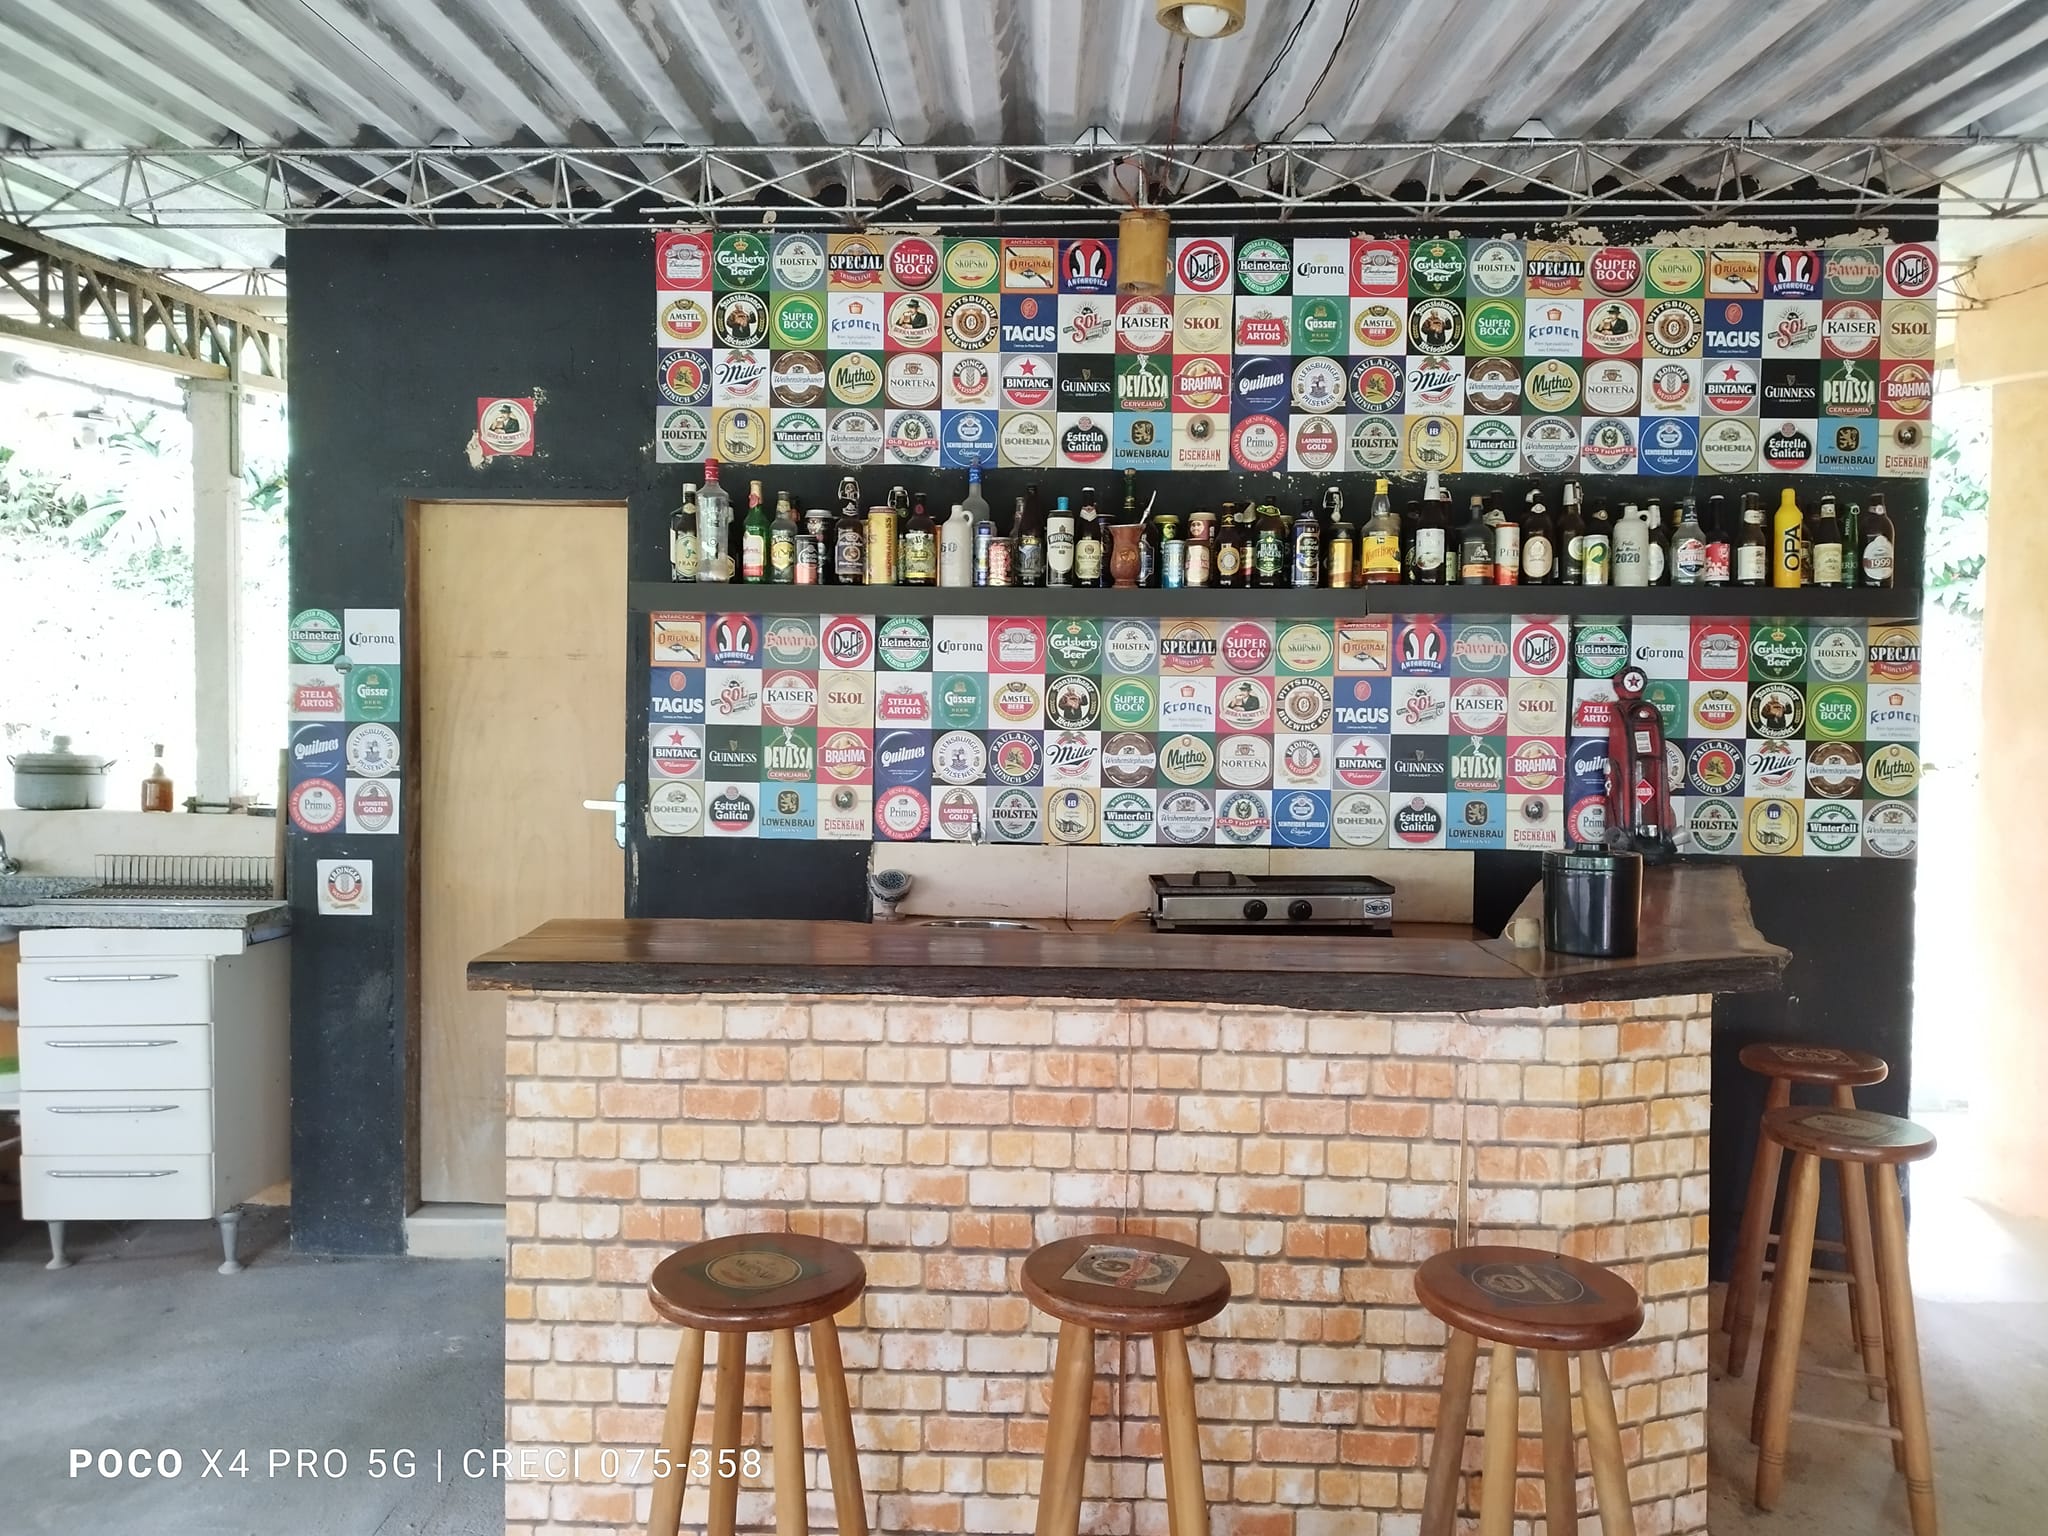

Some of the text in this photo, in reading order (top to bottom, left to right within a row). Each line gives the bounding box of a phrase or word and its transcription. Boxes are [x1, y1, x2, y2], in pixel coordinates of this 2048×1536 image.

[718, 251, 765, 265] Carlsberg
[780, 258, 817, 266] HOLSTEN
[830, 256, 883, 269] SPECJAL
[894, 252, 934, 263] SUPER
[896, 263, 932, 274] BOCK
[955, 260, 988, 268] SKOPSKO
[1009, 260, 1052, 269] ORIGINAL
[1189, 254, 1220, 282] Duff
[1239, 261, 1288, 271] Heineken
[1297, 262, 1344, 278] Corona
[1413, 257, 1462, 272] Carlsberg
[1477, 264, 1516, 272] HOLSTEN
[1529, 262, 1583, 276] SPECJAL
[1595, 258, 1637, 270] SUPER
[730, 267, 755, 276] Beer
[1596, 269, 1635, 281] BOCK
[1826, 263, 1880, 278] Bavaria
[1426, 272, 1451, 282] Beer
[1244, 277, 1284, 292] PREMIUM QUALITY
[947, 296, 997, 318] PITTSBURGH
[1648, 301, 1700, 323] PITTSBURGH
[782, 312, 813, 321] SUPER
[784, 321, 813, 329] BOCK
[1122, 317, 1169, 329] KAISER
[1184, 318, 1222, 329] SKOL
[1247, 323, 1280, 331] STELLA
[1305, 316, 1337, 330] Gösser
[1478, 319, 1511, 328] SUPER
[1828, 322, 1876, 334] KAISER
[1891, 322, 1931, 335] SKOL
[1002, 325, 1056, 342] TAGUS
[1247, 332, 1281, 340] ARTOIS
[1480, 327, 1509, 336] BOCK
[947, 327, 985, 350] BREWING
[985, 327, 997, 342] CO.
[1706, 331, 1760, 348] TAGUS
[661, 351, 707, 372] PAULANER
[954, 360, 987, 376] ERDINGER
[1299, 363, 1340, 382] FLENSBURGER
[1353, 359, 1400, 379] PAULANER
[715, 364, 767, 385] Miller
[837, 367, 875, 388] Mythos
[890, 377, 935, 388] NORTEÑA
[1007, 378, 1048, 388] BINTANG
[1061, 380, 1110, 392] GUINNESS
[1118, 375, 1168, 398] DEVASSA
[1181, 377, 1222, 392] BRAHMA
[1239, 373, 1284, 395] Quilmes
[1408, 371, 1462, 392] Miller
[1532, 375, 1573, 396] Mythos
[661, 382, 709, 403] MUNICH BIER
[1708, 384, 1753, 394] BINTANG
[1765, 386, 1816, 398] GUINNESS
[1823, 381, 1875, 404] DEVASSA
[1888, 382, 1931, 397] BRAHMA
[1302, 394, 1336, 407] PILSENER
[1352, 390, 1401, 411] MUNICH BIER
[661, 430, 707, 440] HOLSTEN
[777, 432, 821, 441] Winterfell
[1067, 432, 1104, 442] Estrella
[1068, 442, 1101, 451] Galicia
[1247, 437, 1274, 448] Primus
[1351, 439, 1398, 448] HOLSTEN
[1469, 439, 1516, 449] Winterfell
[1705, 444, 1752, 452] BOHEMIA
[1768, 438, 1807, 449] Estrella
[1179, 449, 1220, 462] EISENBAHN
[1770, 448, 1805, 458] Galicia
[1785, 523, 1800, 571] OPA
[1615, 553, 1640, 564] 2020
[1871, 558, 1891, 569] 1999
[292, 630, 340, 640] Heineken
[349, 633, 395, 646] Corona
[881, 637, 929, 648] Heineken
[937, 640, 983, 655] Corona
[1050, 634, 1097, 649] Carlsberg
[1112, 642, 1150, 651] HOLSTEN
[1162, 640, 1215, 654] SPECJAL
[1226, 637, 1267, 649] SUPER
[1064, 650, 1087, 659] Beer
[1228, 648, 1266, 659] BOCK
[1577, 645, 1626, 654] Heineken
[1636, 646, 1684, 661] Corona
[1753, 641, 1803, 656] Carlsberg
[1818, 649, 1857, 658] HOLSTEN
[1766, 658, 1792, 667] Beer
[300, 690, 334, 699] STELLA
[767, 690, 814, 702] KAISER
[828, 692, 864, 704] SKOL
[1114, 695, 1145, 703] SUPER
[653, 697, 703, 713] TAGUS
[888, 698, 921, 706] STELLA
[1115, 703, 1144, 712] BOCK
[1456, 698, 1503, 711] KAISER
[1519, 700, 1557, 712] SKOL
[1702, 703, 1733, 711] AMSTEL
[1819, 702, 1852, 712] SUPER
[888, 707, 921, 715] ARTOIS
[1335, 708, 1389, 723] TAGUS
[1821, 711, 1851, 720] BOCK
[993, 733, 1039, 752] PAULANER
[295, 739, 339, 759] Quilmes
[655, 749, 697, 757] BINTANG
[1046, 744, 1097, 766] Miller
[709, 751, 758, 763] GUINNESS
[764, 746, 813, 769] DEVASSA
[825, 749, 866, 763] BRAHMA
[882, 746, 925, 767] Quilmes
[1167, 749, 1207, 770] Mythos
[1339, 759, 1383, 769] BINTANG
[1394, 761, 1444, 773] GUINNESS
[1515, 758, 1557, 773] BRAHMA
[305, 799, 331, 810] Primus
[654, 805, 698, 814] BOHEMIA
[714, 801, 750, 811] Estrella
[715, 811, 748, 820] Galicia
[890, 807, 917, 818] Primus
[948, 813, 969, 821] GOLD
[992, 810, 1038, 819] HOLSTEN
[1106, 812, 1152, 821] Winterfell
[1691, 820, 1738, 831] HOLSTEN
[1810, 823, 1858, 833] Winterfell
